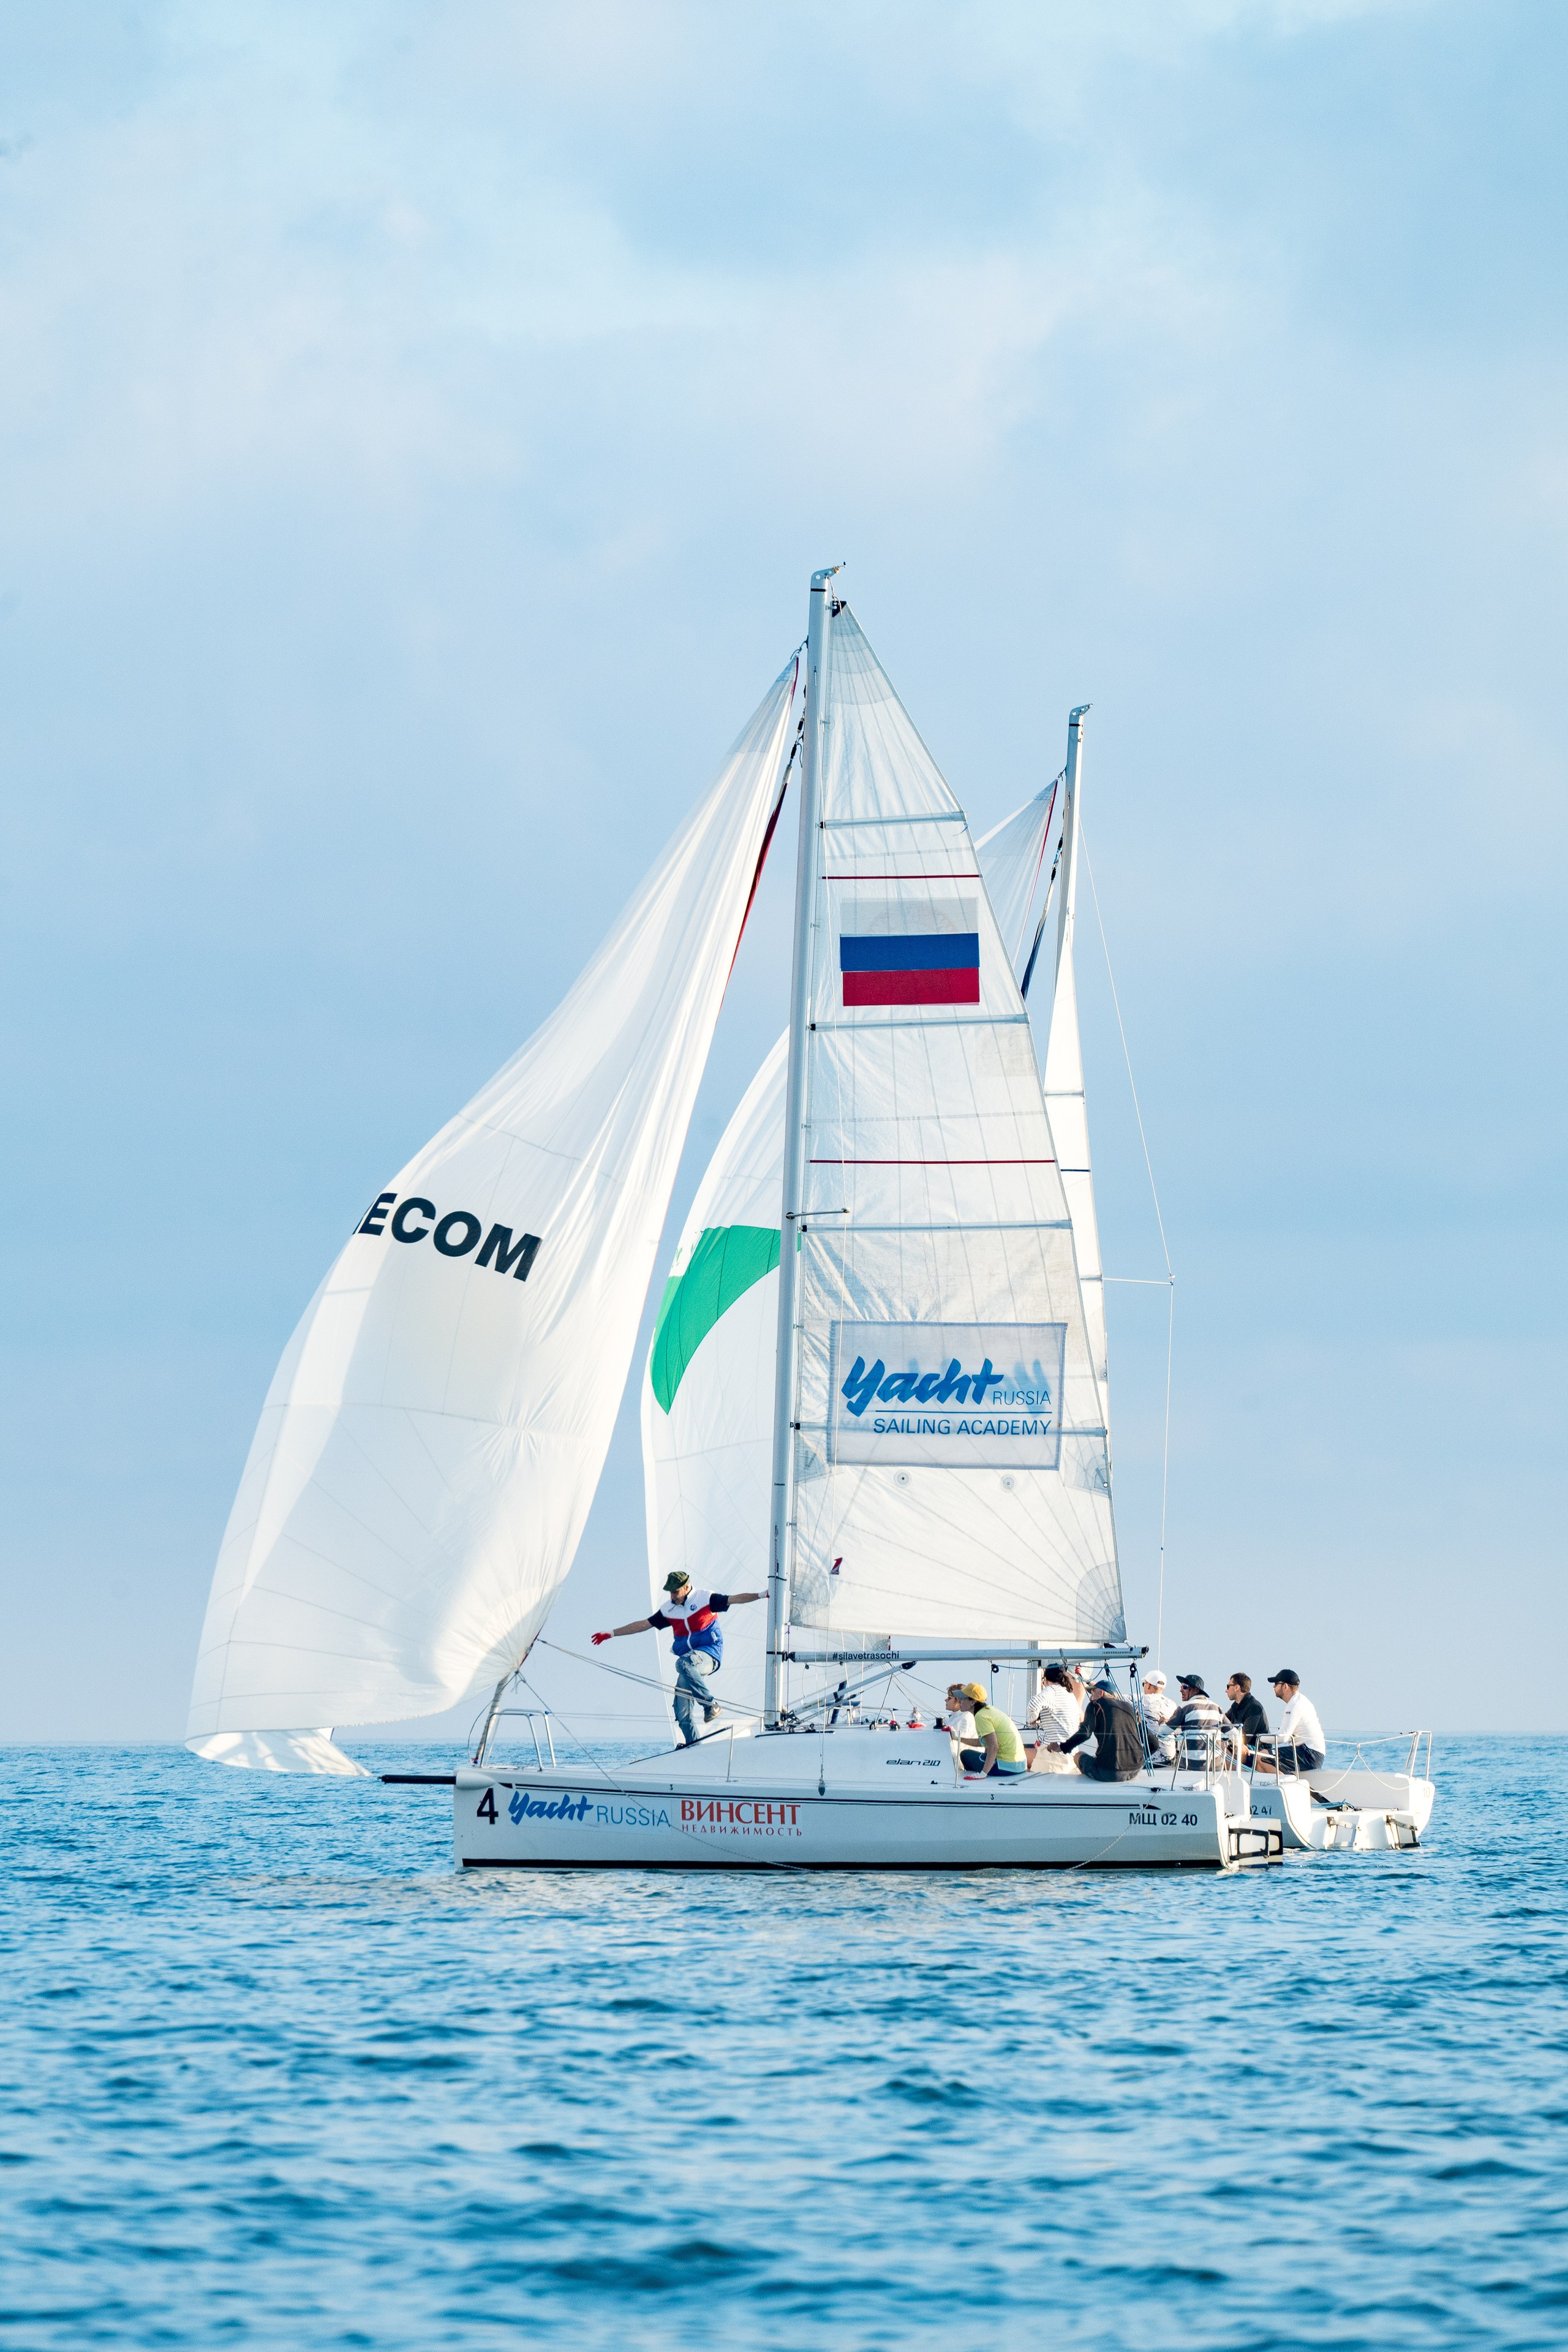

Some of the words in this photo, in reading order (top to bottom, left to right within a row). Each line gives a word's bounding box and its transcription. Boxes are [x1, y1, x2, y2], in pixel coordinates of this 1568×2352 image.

[352, 1193, 543, 1281] ECOM
[992, 1390, 1052, 1406] RUSSIA
[873, 1418, 951, 1435] SAILING
[957, 1419, 1052, 1436] ACADEMY
[832, 1651, 900, 1660] #silavetrasochi
[477, 1788, 499, 1825] 4
[681, 1800, 801, 1825] ВИНСЕНТ
[597, 1805, 671, 1827] RUSSIA
[1161, 1814, 1177, 1825] 02
[1181, 1814, 1198, 1826] 40
[682, 1824, 802, 1836] НЕДВИЖИМОСТЬ
